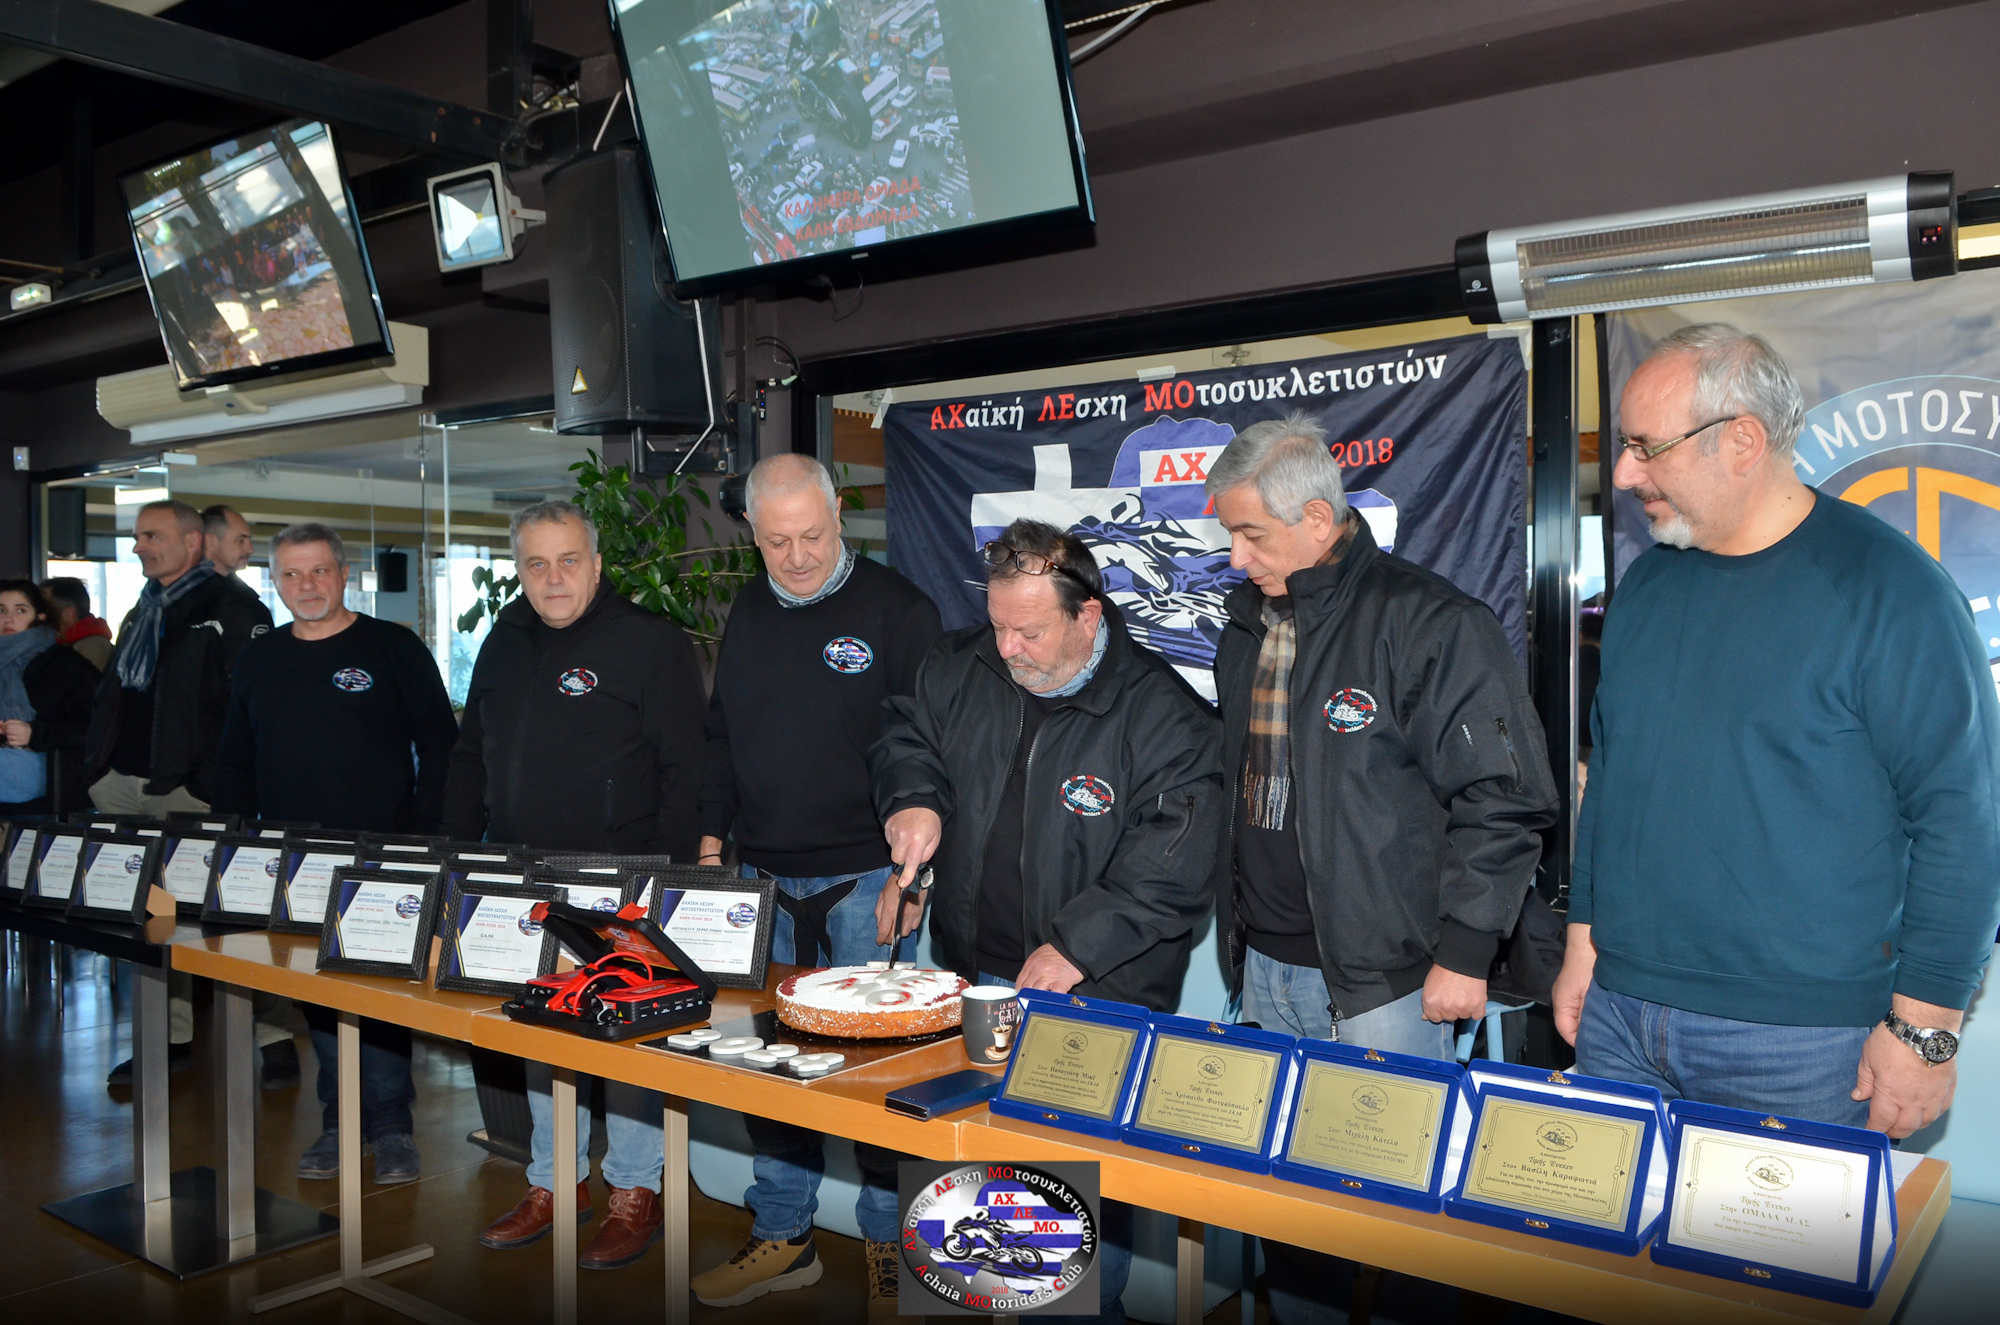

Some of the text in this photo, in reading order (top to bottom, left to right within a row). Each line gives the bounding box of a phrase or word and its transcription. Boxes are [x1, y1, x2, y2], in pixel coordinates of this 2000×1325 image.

[785, 176, 921, 218] ΚΑΛΗΜΕΡΑ ΟΜΑΔΑ
[795, 204, 920, 241] ΚΑΛΗ ΕΒΔΟΜΑΔΑ
[930, 351, 1447, 431] ΑΧαϊκή ΛΕσχη ΜΟτοσυκλετιστών
[1332, 438, 1394, 468] 2018
[1521, 1165, 1548, 1177] Βασίλη
[1552, 1171, 1597, 1185] Καραφωτιά
